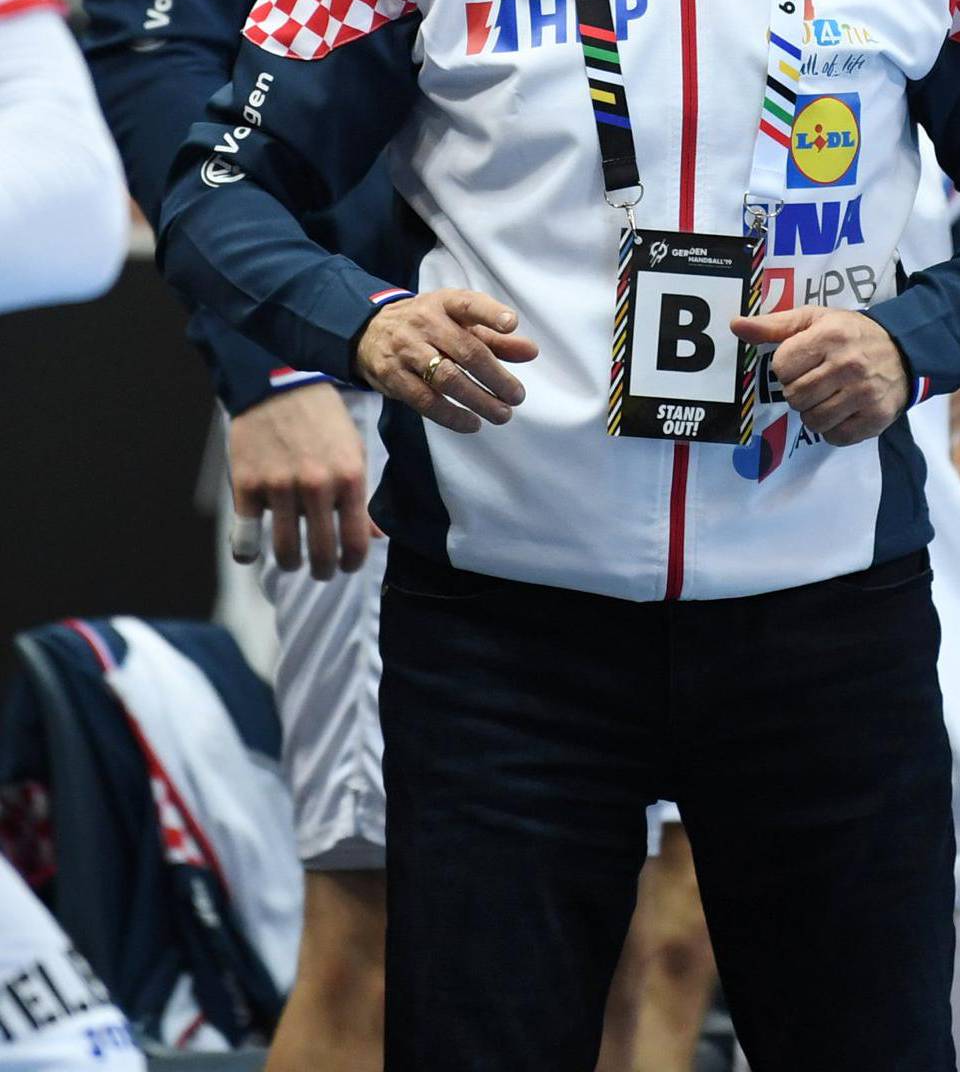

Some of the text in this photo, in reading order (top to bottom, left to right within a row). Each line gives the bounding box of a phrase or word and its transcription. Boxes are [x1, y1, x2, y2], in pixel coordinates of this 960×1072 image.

[803, 265, 877, 307] HPB
[656, 293, 716, 373] B
[656, 404, 706, 422] STAND
[662, 420, 699, 438] OUT!
